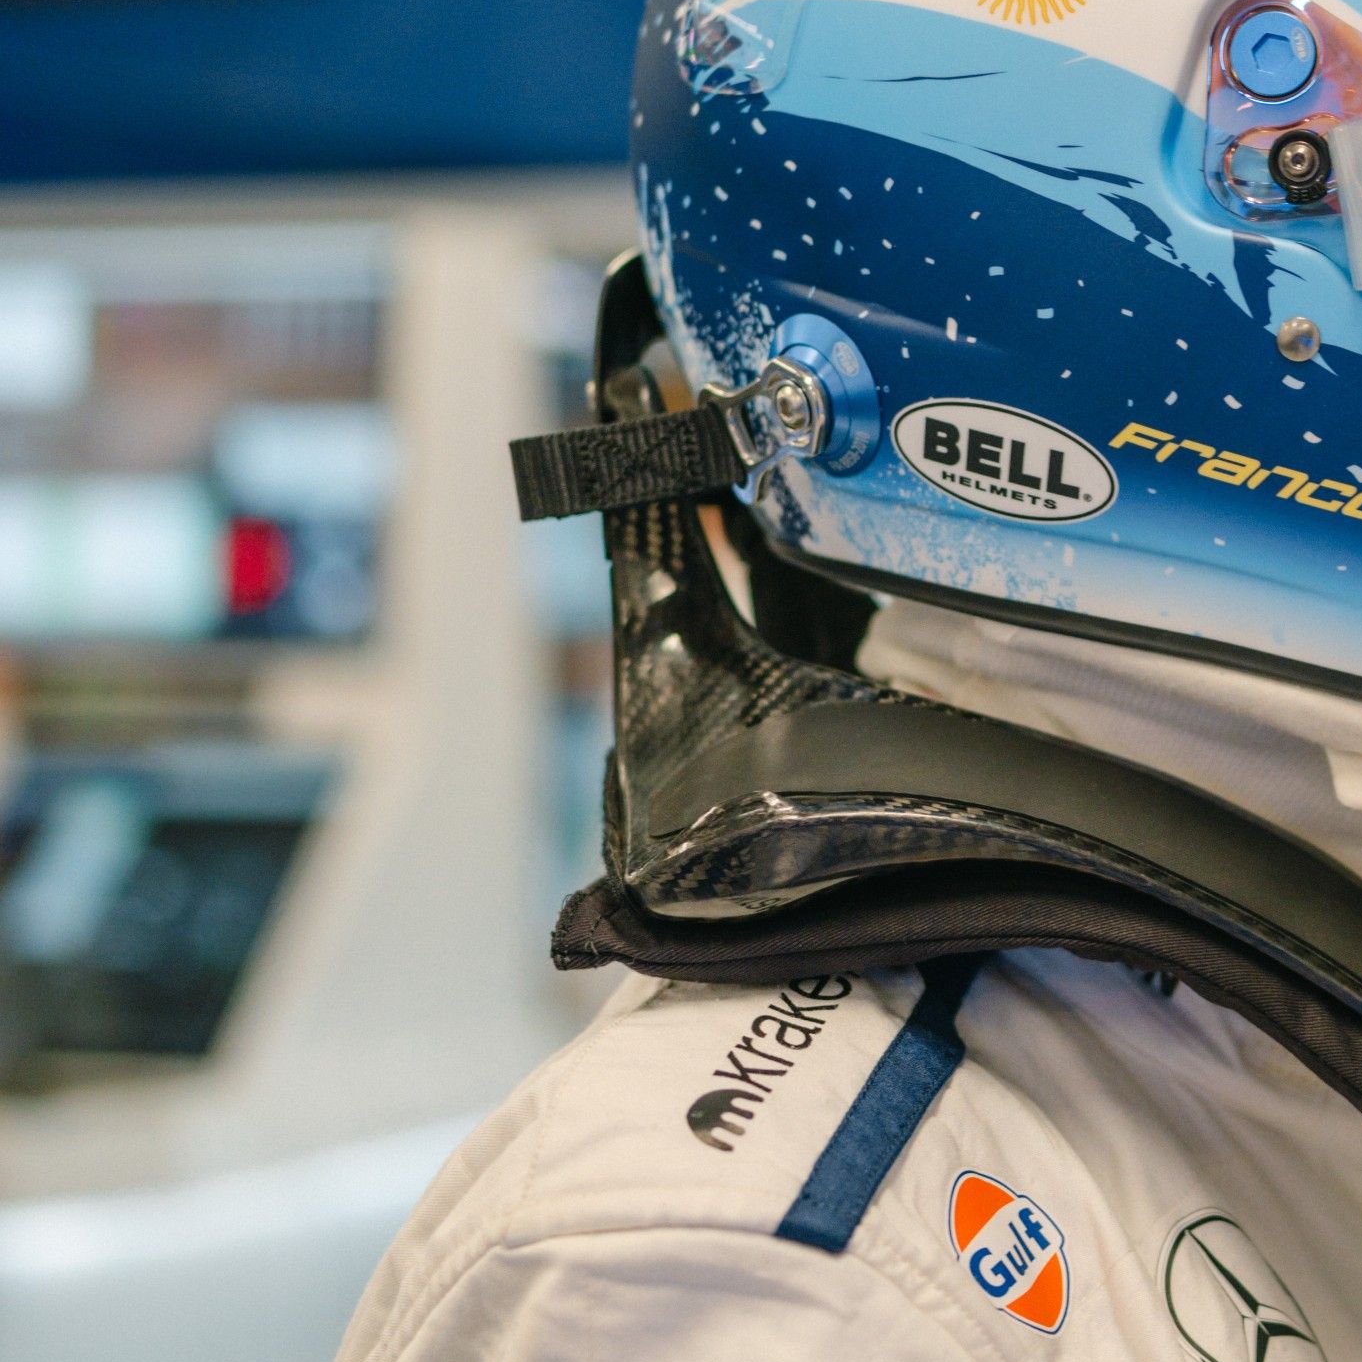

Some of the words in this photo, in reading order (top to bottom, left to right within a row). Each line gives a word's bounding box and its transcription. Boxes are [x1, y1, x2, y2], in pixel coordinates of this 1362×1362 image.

[923, 416, 1080, 500] BELL
[941, 469, 1058, 510] HELMETS
[968, 1207, 1051, 1298] Gulf
